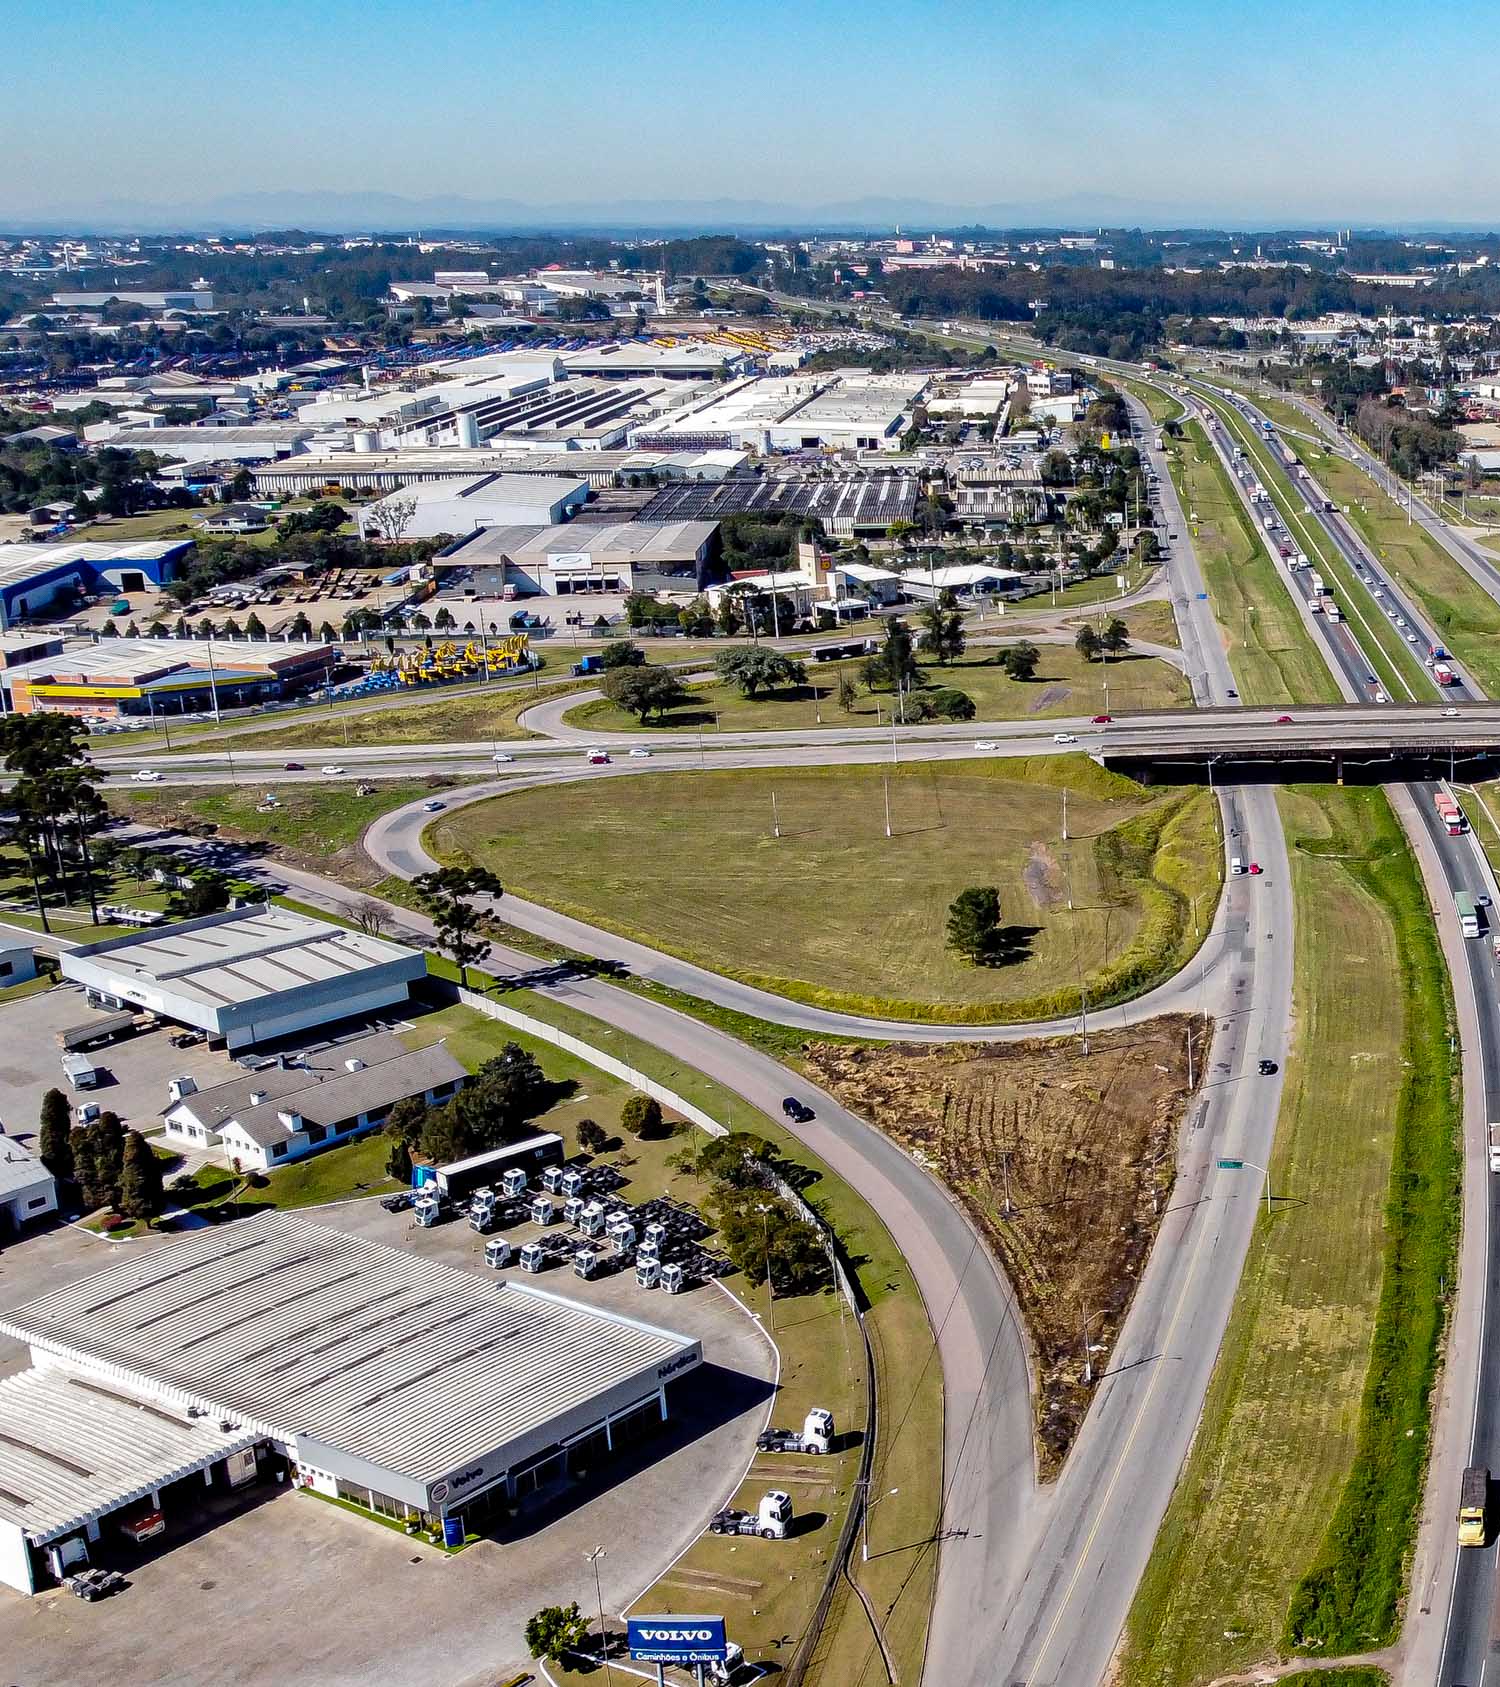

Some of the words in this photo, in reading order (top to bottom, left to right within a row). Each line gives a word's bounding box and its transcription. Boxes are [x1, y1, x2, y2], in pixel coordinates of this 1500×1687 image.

[451, 1467, 484, 1489] Volvo
[637, 1629, 713, 1641] VOLVO
[689, 1651, 720, 1661] Ônibus
